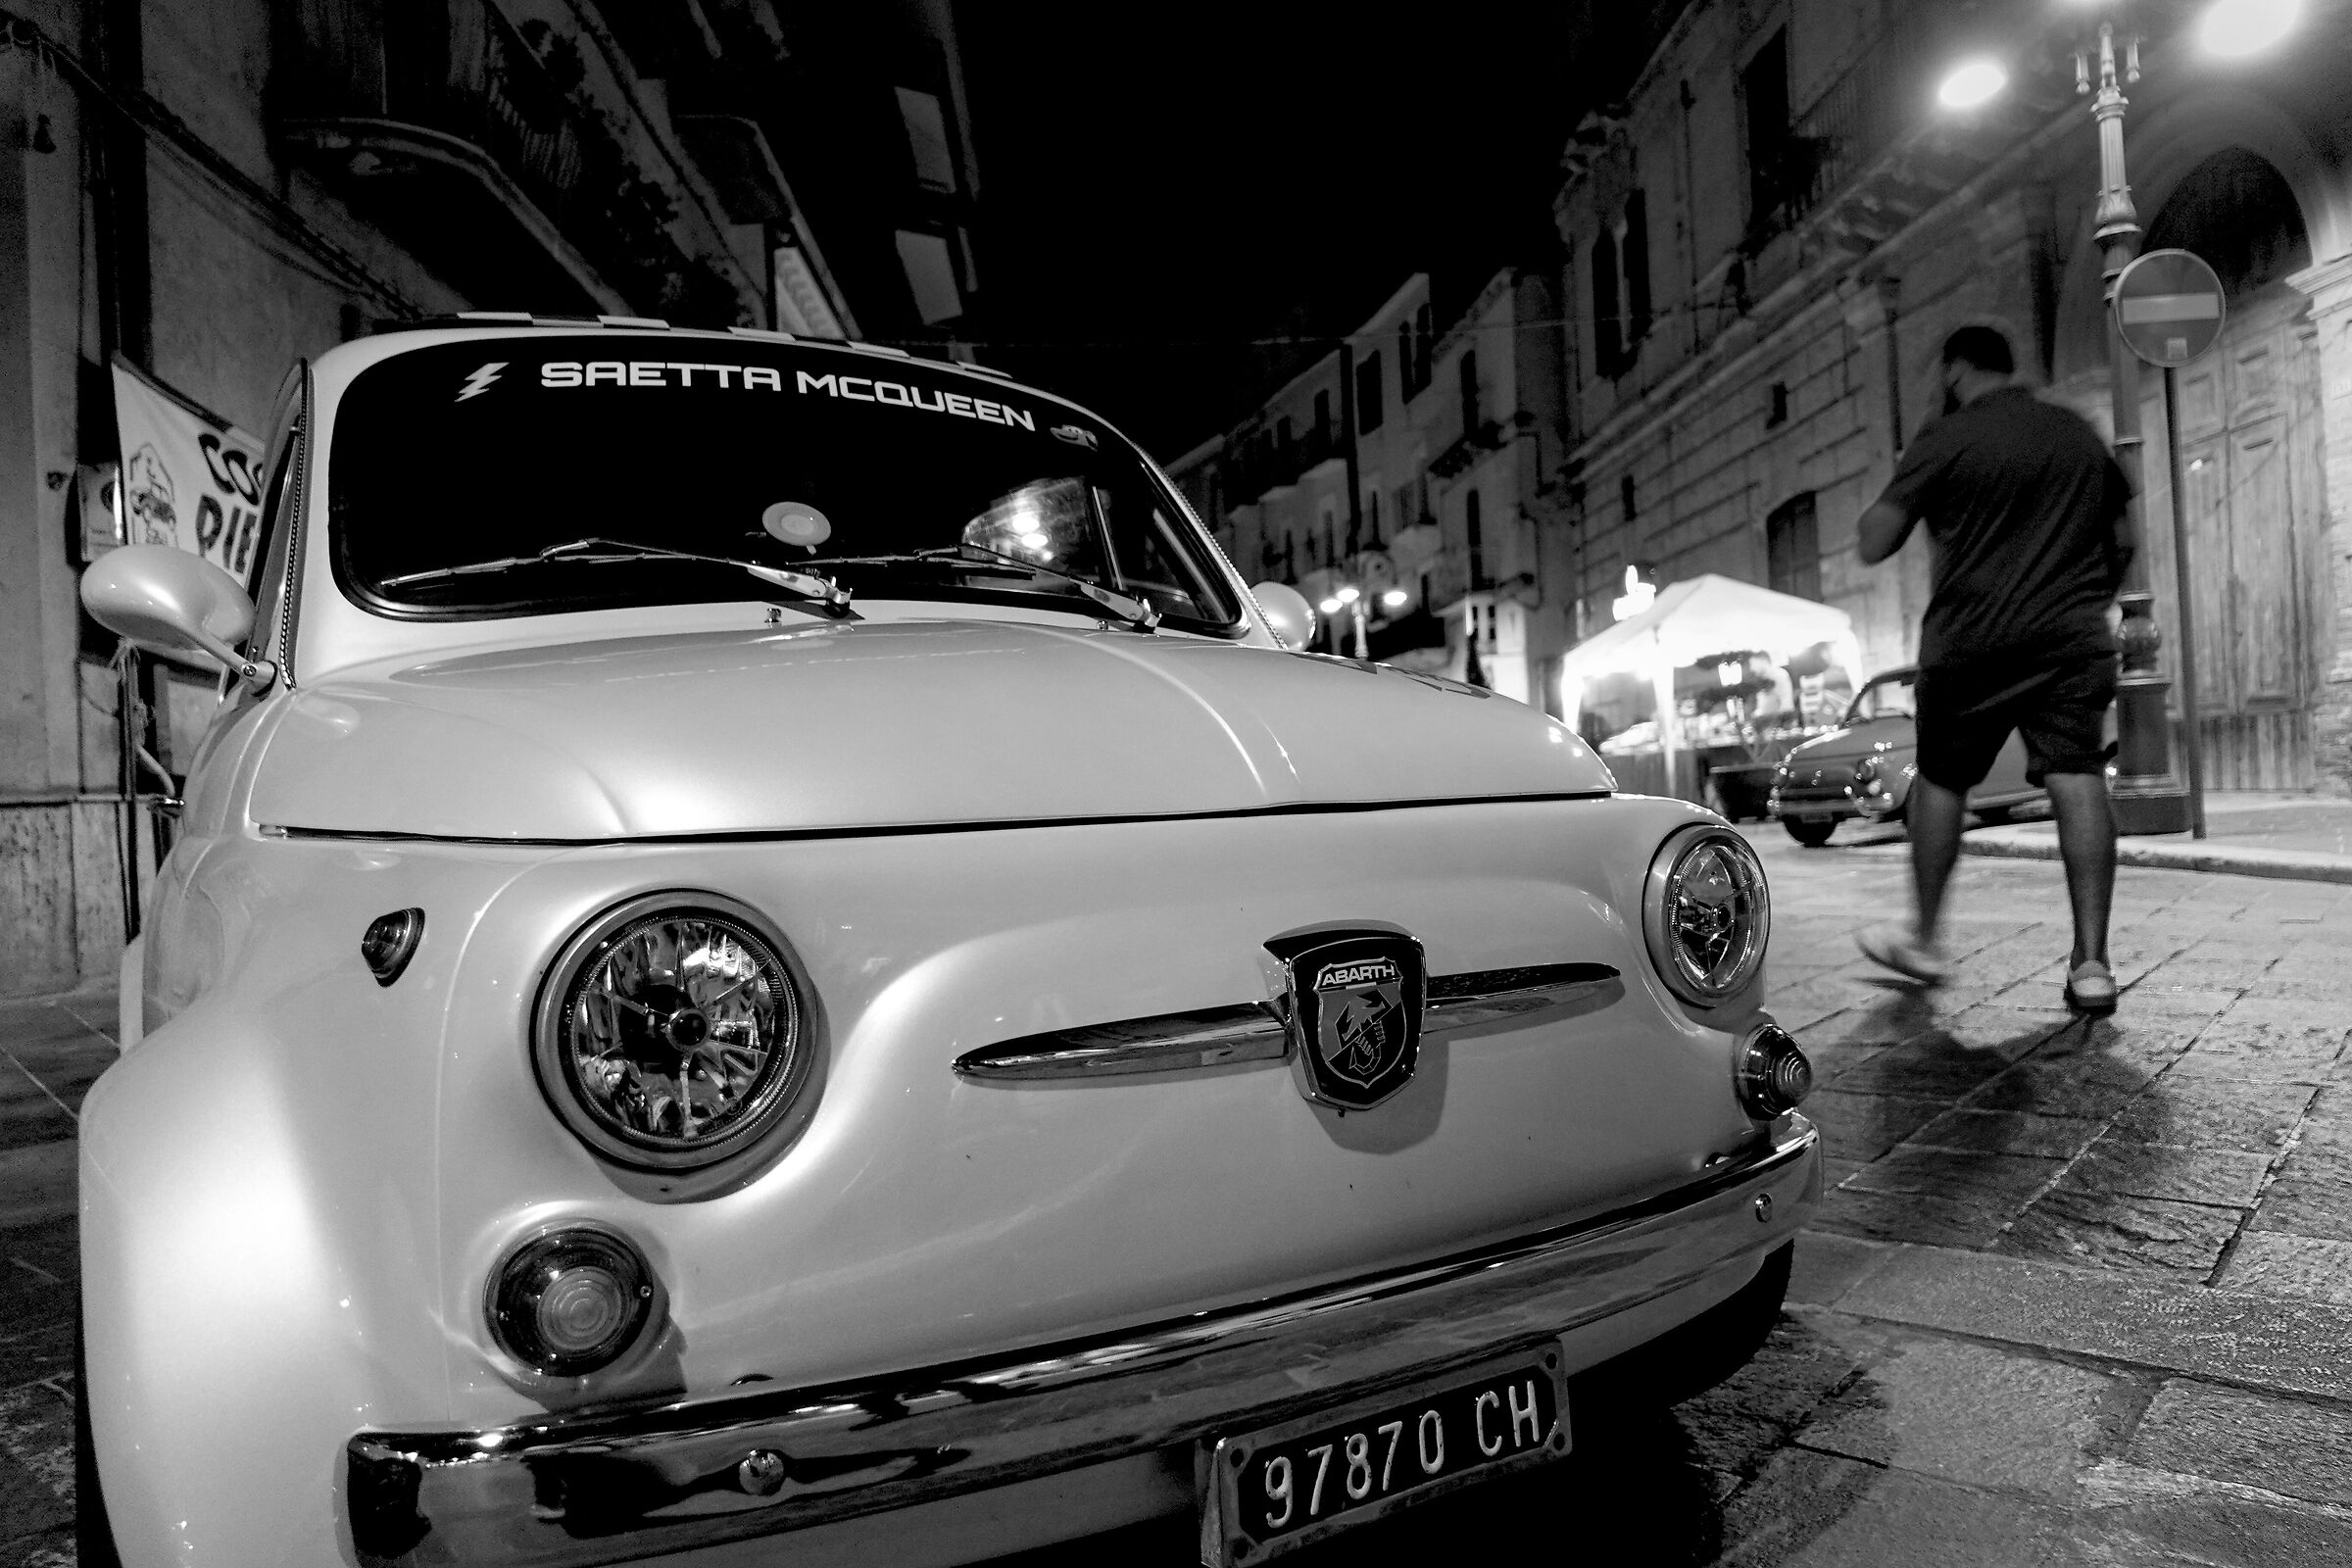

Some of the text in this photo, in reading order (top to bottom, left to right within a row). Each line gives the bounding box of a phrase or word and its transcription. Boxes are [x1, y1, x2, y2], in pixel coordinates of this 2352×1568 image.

[541, 362, 1036, 431] SAETTA MCQUEEN
[1322, 965, 1396, 986] ABARTH
[1264, 1380, 1540, 1528] 97870 CH
